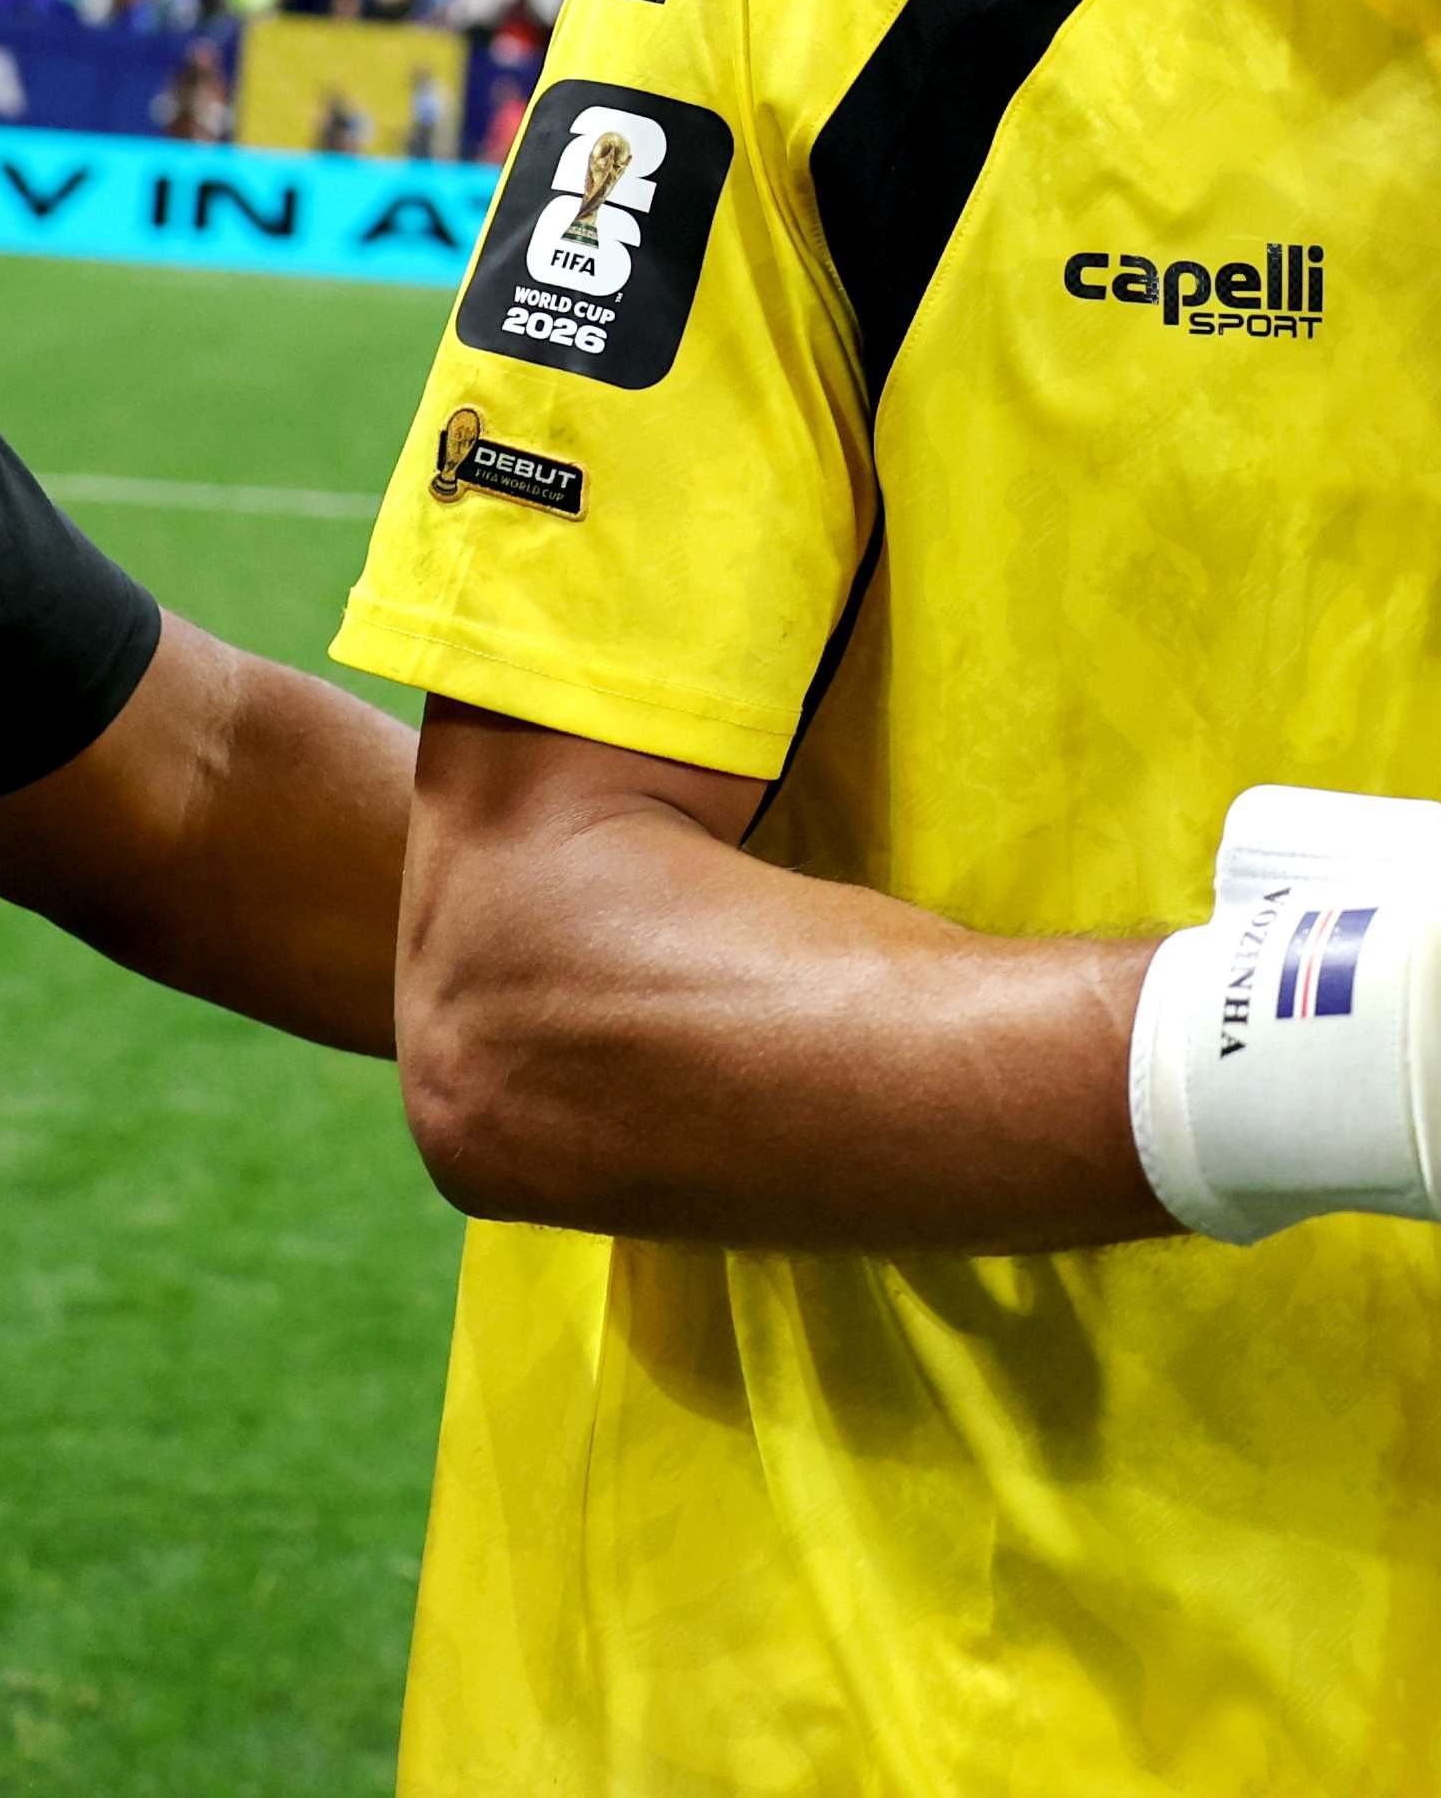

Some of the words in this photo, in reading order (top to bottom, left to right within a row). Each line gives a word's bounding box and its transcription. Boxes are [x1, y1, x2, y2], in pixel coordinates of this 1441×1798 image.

[151, 174, 297, 236] IN
[550, 249, 596, 277] FIFA
[1064, 243, 1324, 325] capelli
[514, 286, 572, 313] WORLD
[573, 301, 616, 325] CUP
[1189, 312, 1323, 339] SPORT
[502, 306, 608, 354] 2026
[474, 446, 577, 489] DEBUT
[474, 469, 498, 483] FIFA
[501, 476, 540, 495] WORLD
[542, 488, 565, 502] CUP
[1220, 887, 1291, 1059] VOZINHA
